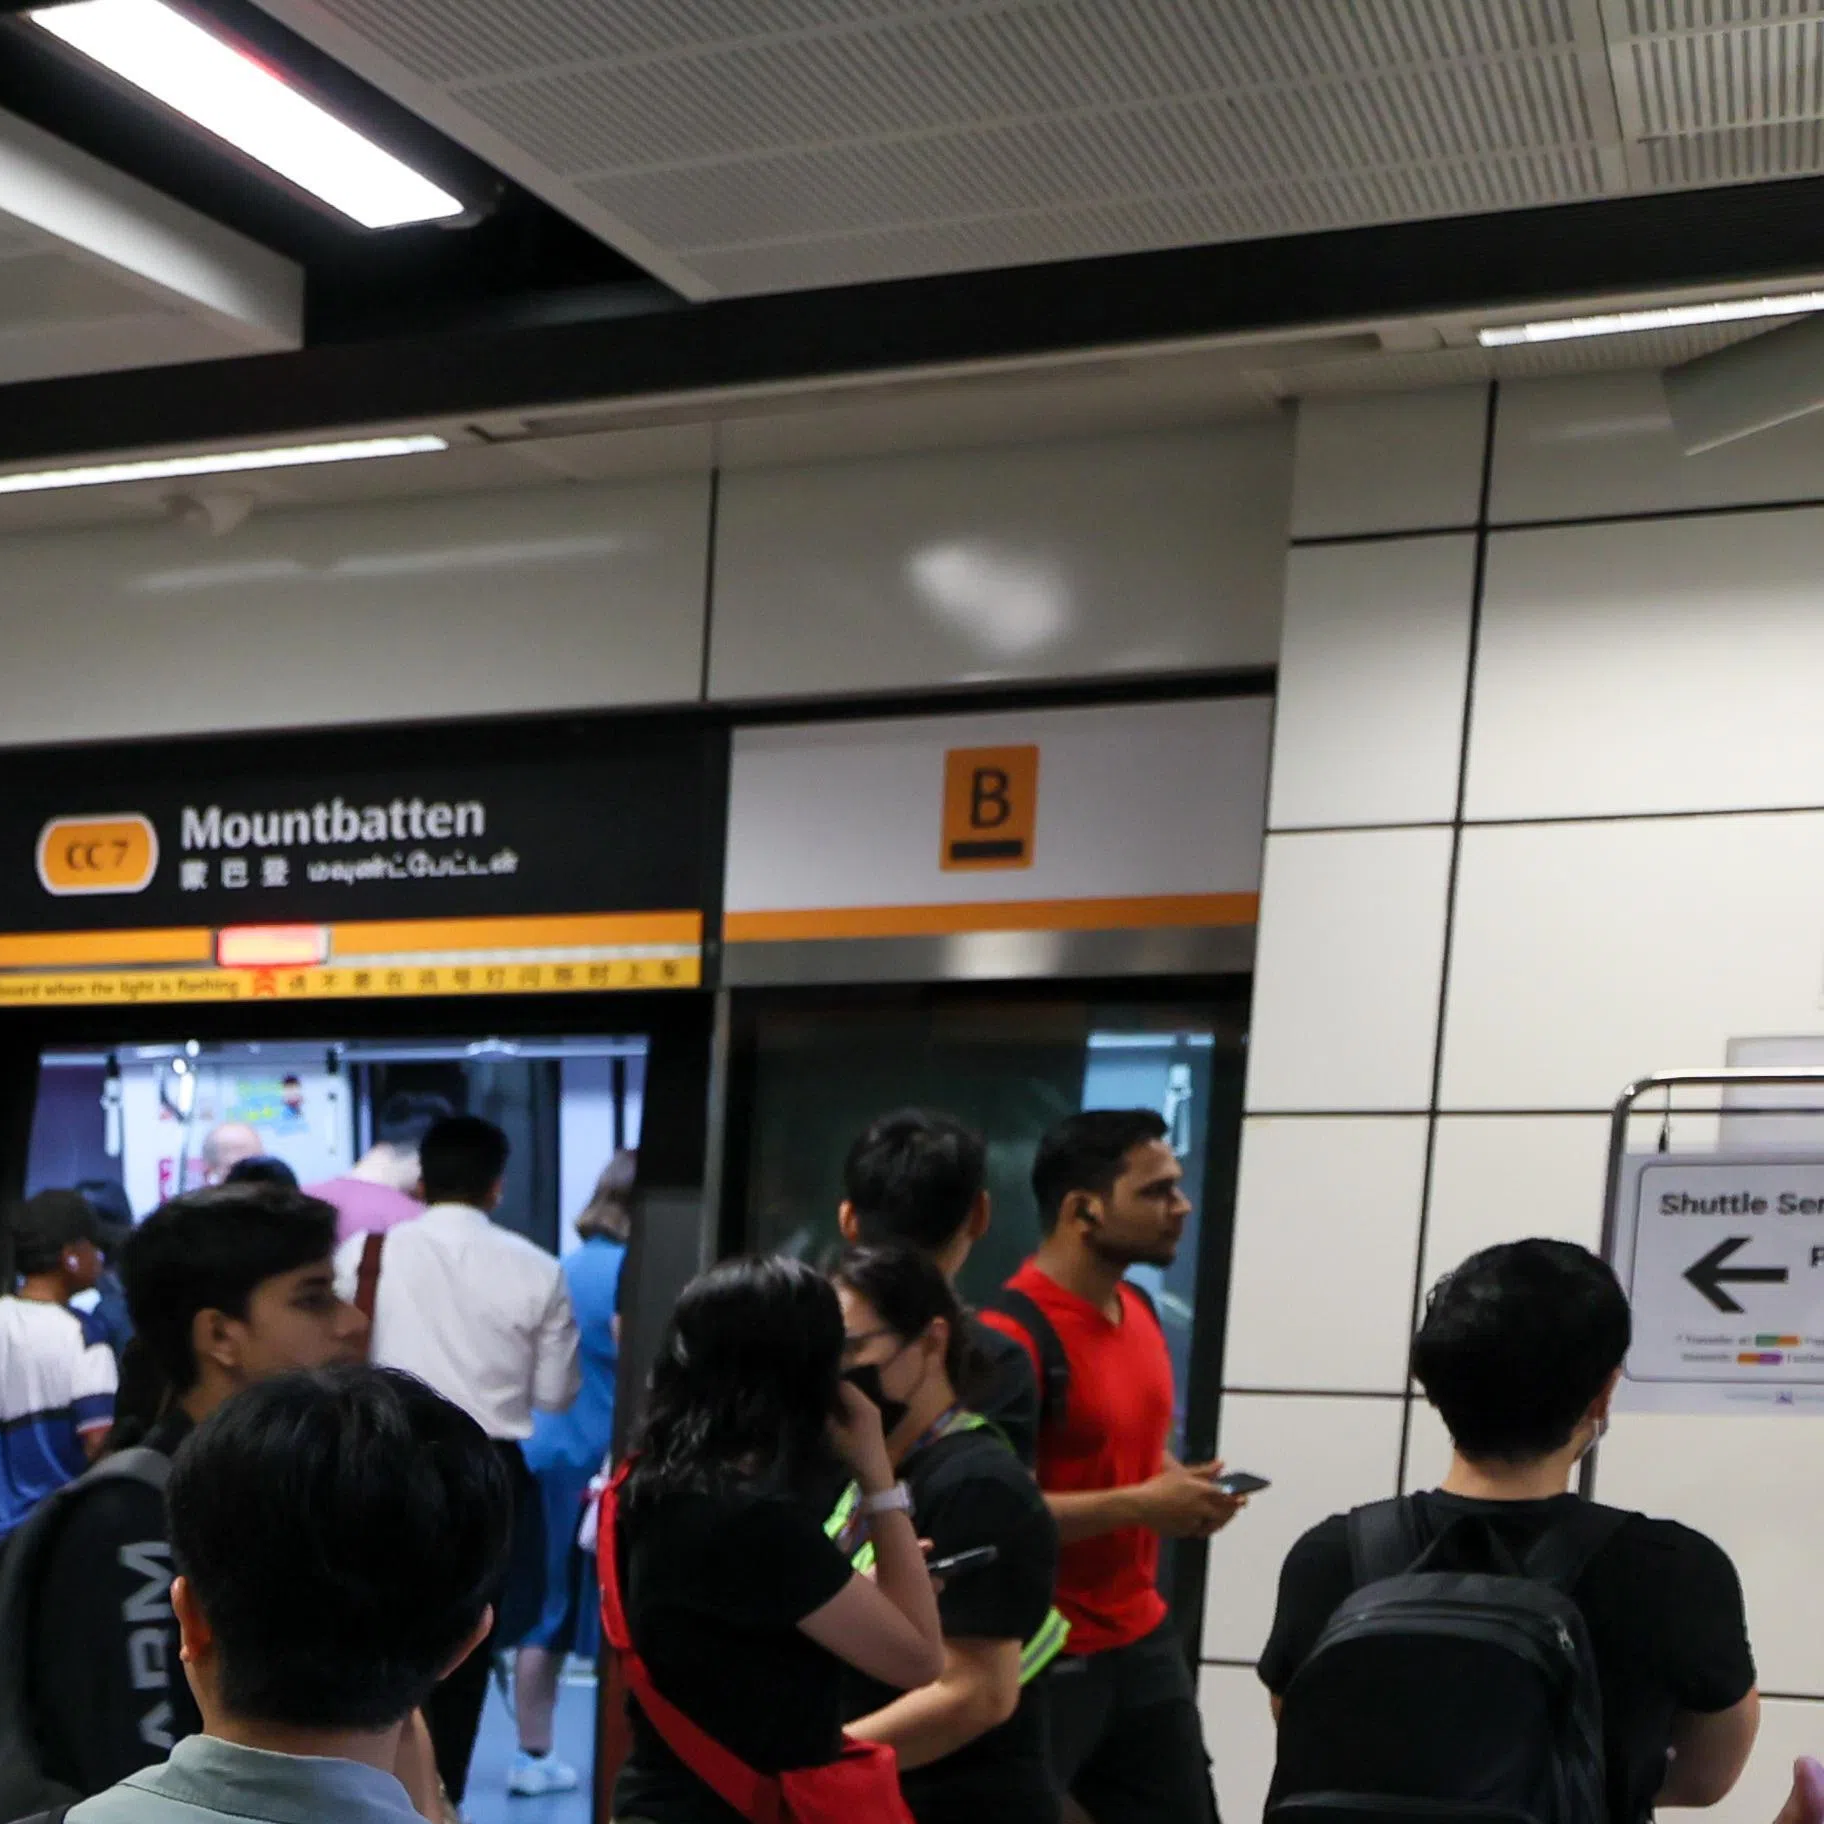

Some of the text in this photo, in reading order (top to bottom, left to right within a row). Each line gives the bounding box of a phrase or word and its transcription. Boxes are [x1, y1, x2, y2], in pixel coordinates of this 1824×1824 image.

[180, 798, 486, 851] Mountbatten
[970, 767, 1011, 829] B
[1659, 1191, 1769, 1216] Shuttle
